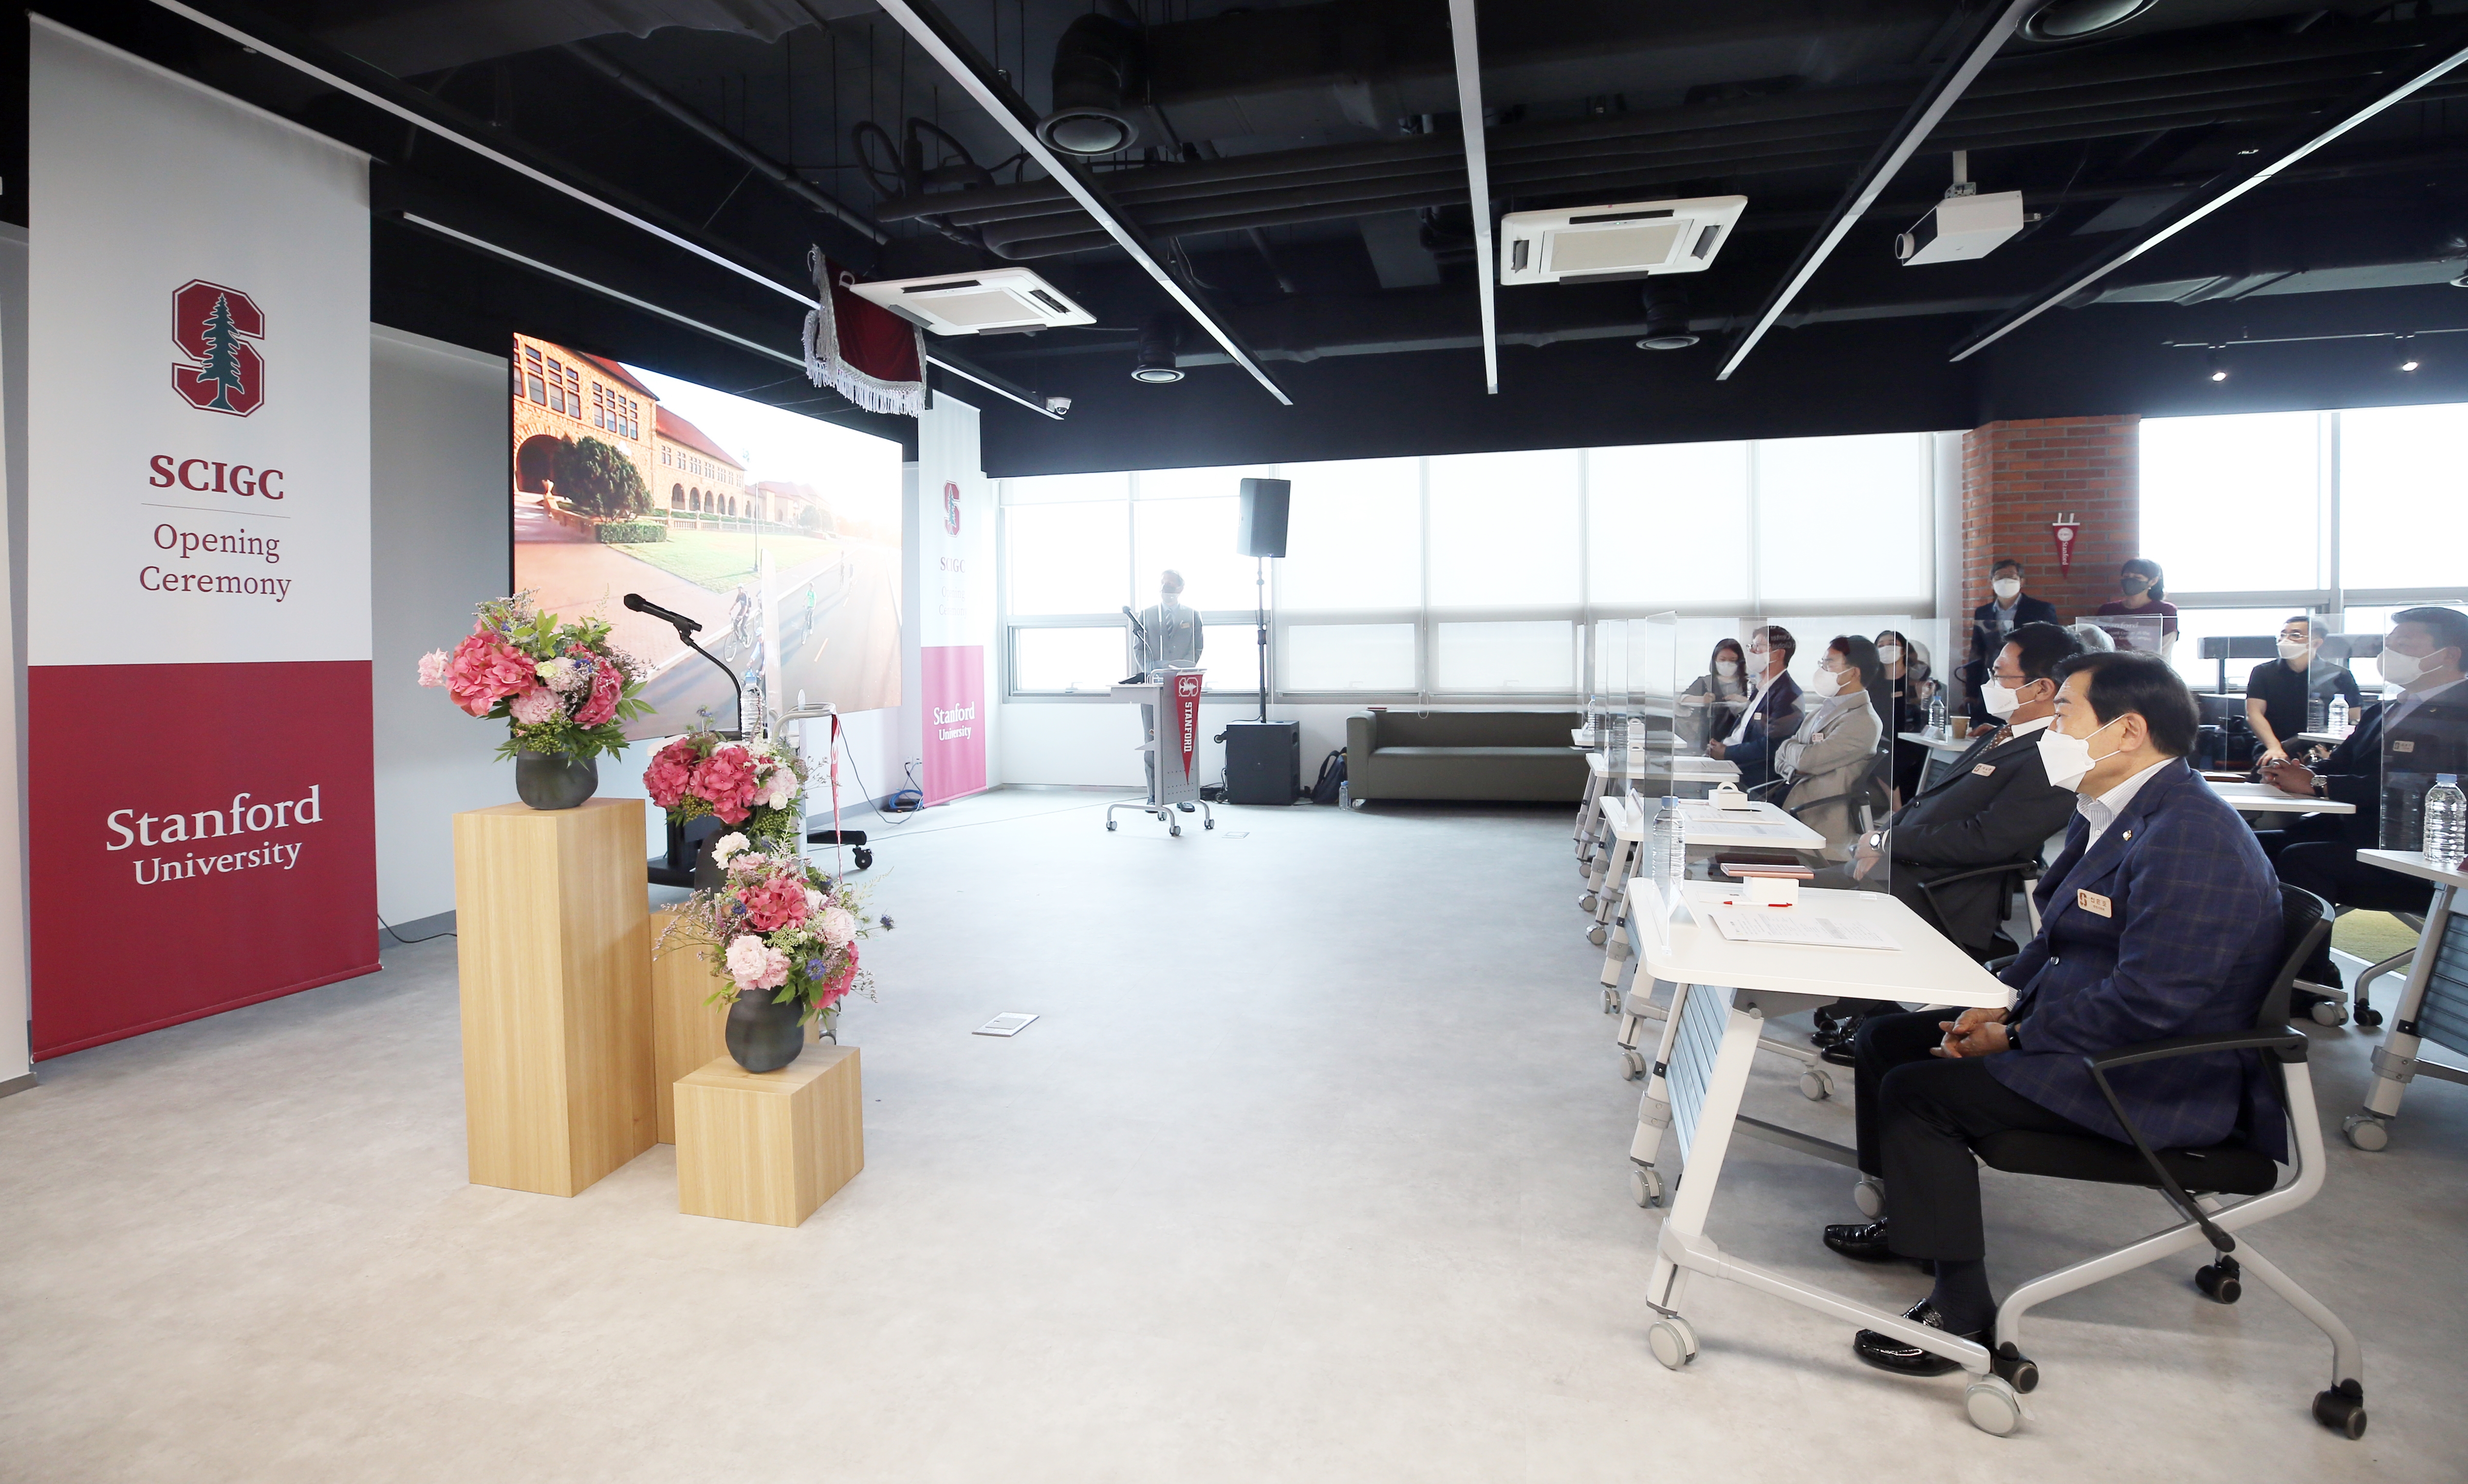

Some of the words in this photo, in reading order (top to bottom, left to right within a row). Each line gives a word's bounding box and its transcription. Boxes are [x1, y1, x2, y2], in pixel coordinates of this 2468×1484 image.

[149, 455, 284, 500] SCIGC
[153, 523, 280, 564] Opening
[940, 556, 966, 573] SCIGC
[139, 566, 292, 603] Ceremony
[942, 586, 965, 602] Opening
[939, 604, 968, 619] Ceremony
[933, 701, 975, 726] Stanford
[939, 724, 972, 742] University
[106, 784, 323, 852] Stanford
[133, 841, 302, 885] University
